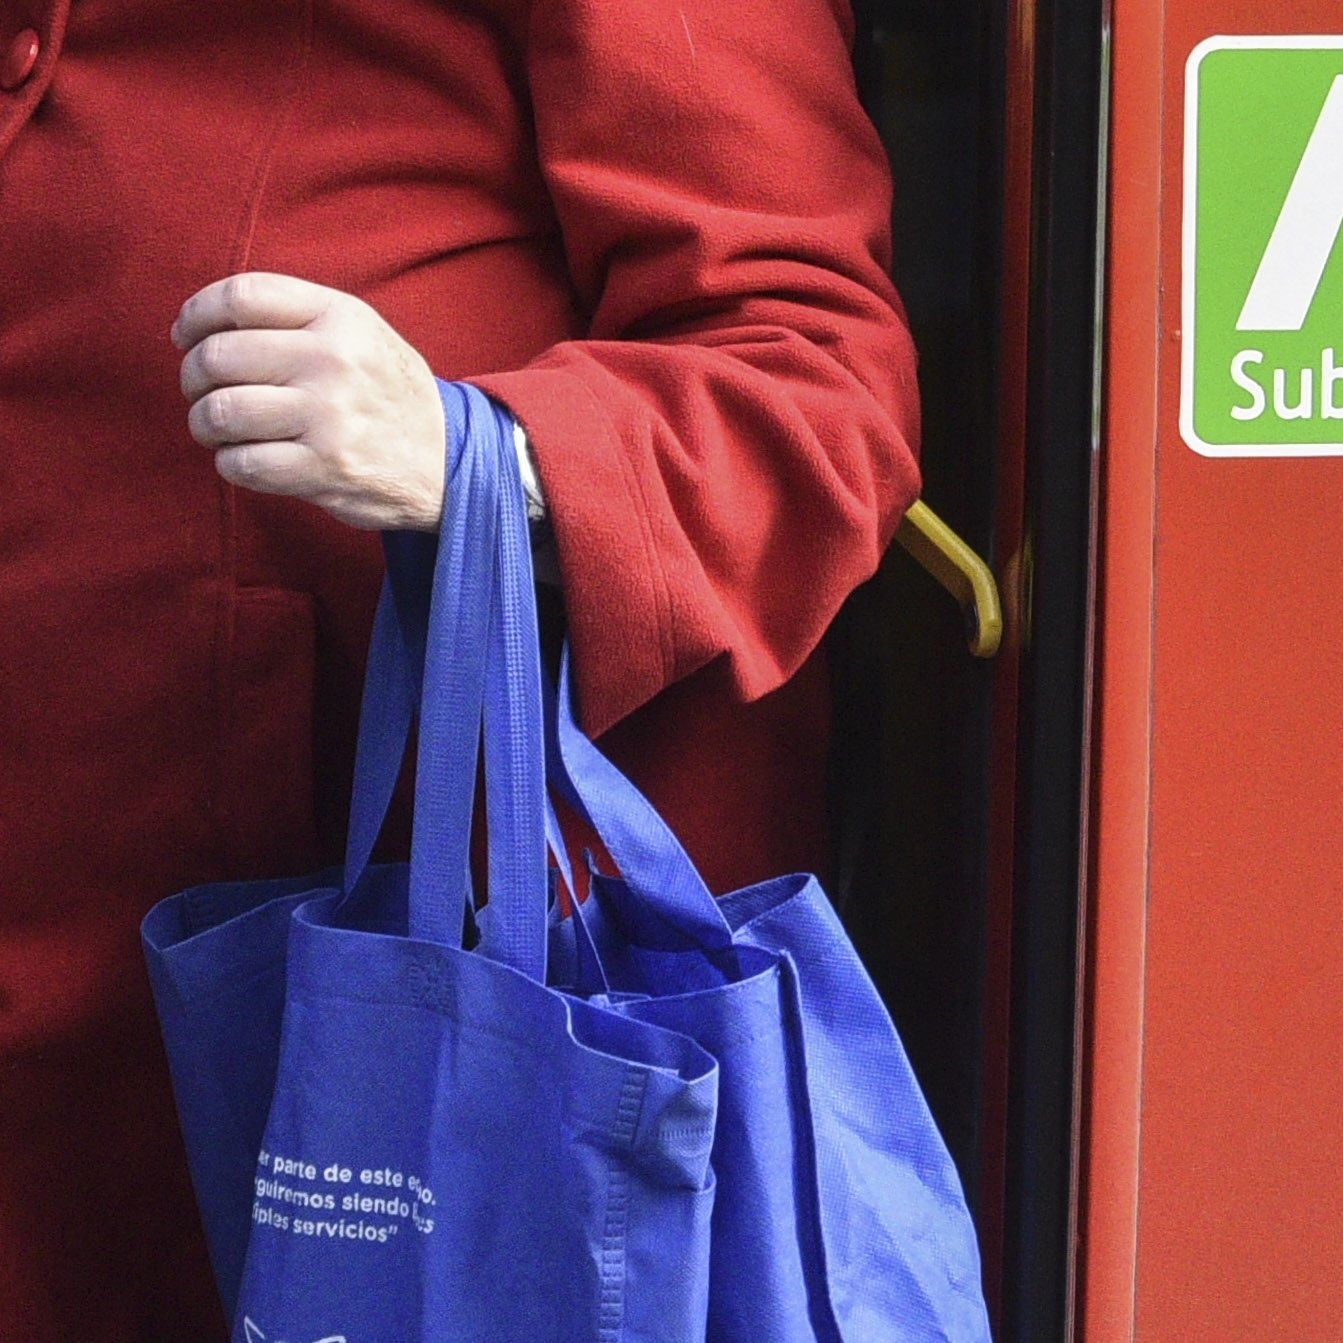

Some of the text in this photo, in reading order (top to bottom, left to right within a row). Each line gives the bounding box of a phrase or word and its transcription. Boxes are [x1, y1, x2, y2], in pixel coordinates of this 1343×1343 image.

[273, 1155, 317, 1180] parte
[323, 1163, 353, 1183] de
[360, 1167, 403, 1188] este
[341, 1192, 409, 1218] siendo
